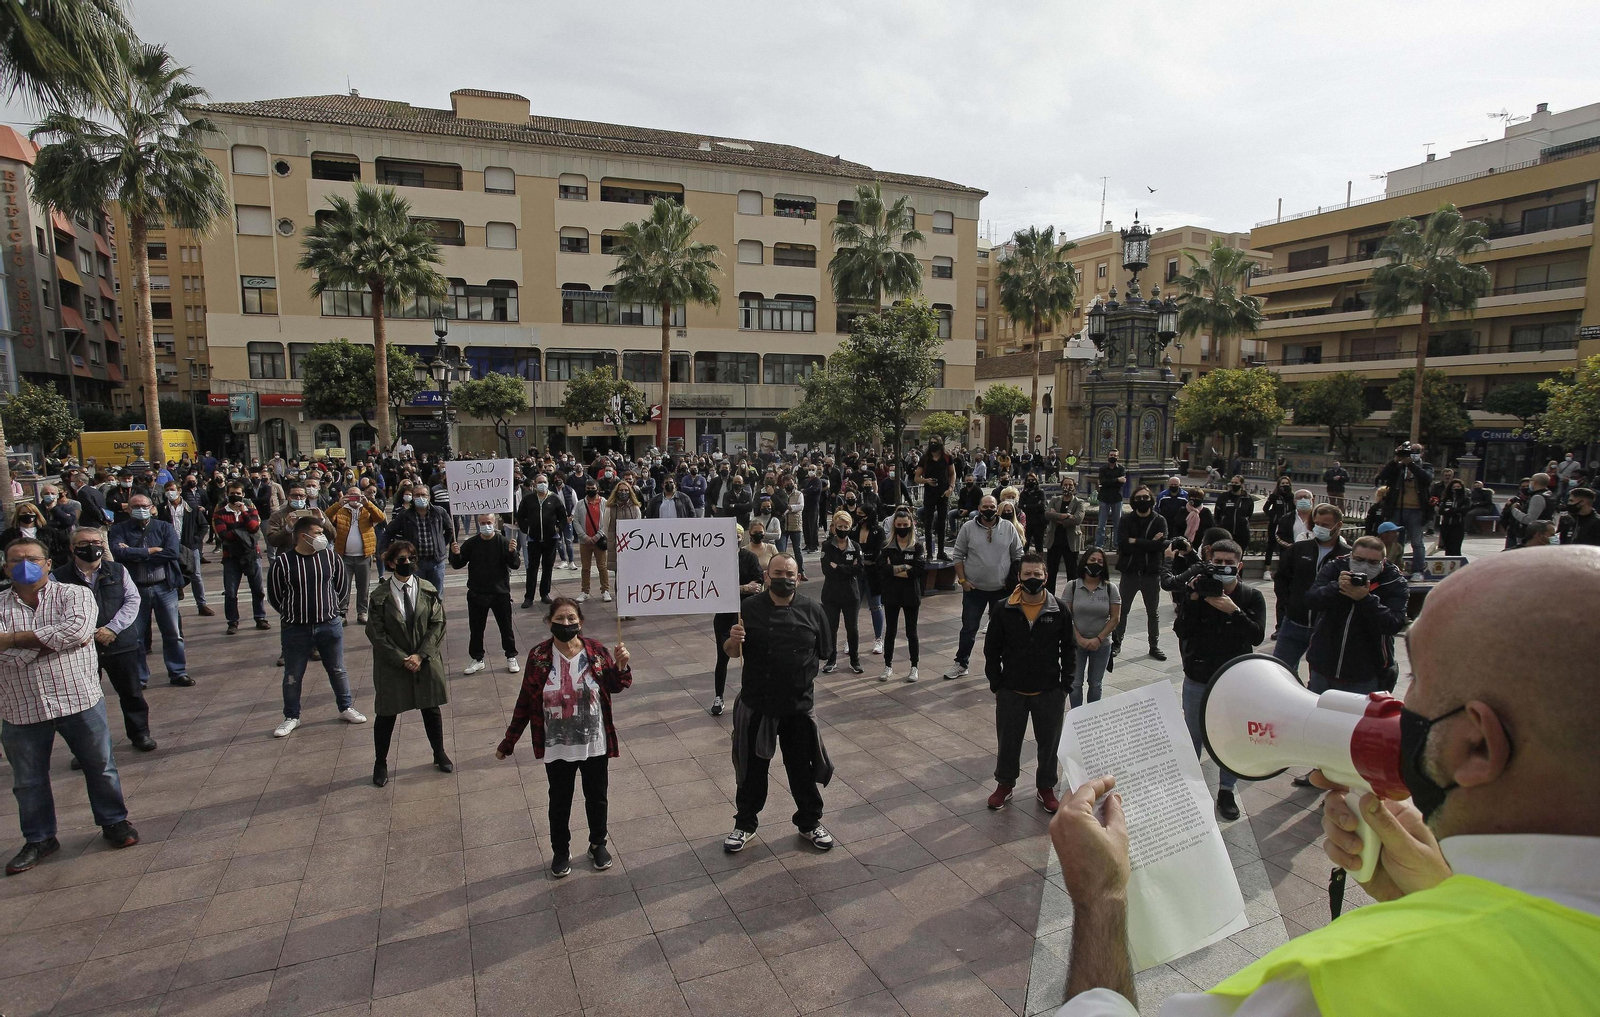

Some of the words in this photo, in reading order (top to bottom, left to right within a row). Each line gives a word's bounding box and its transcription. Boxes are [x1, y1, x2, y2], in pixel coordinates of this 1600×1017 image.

[3, 170, 26, 267] EDIFICIO
[16, 278, 36, 349] CENTRO
[466, 462, 494, 475] SOLO
[451, 477, 509, 493] QUEREMOS
[452, 497, 509, 512] TRABAJAR
[665, 554, 688, 570] LA
